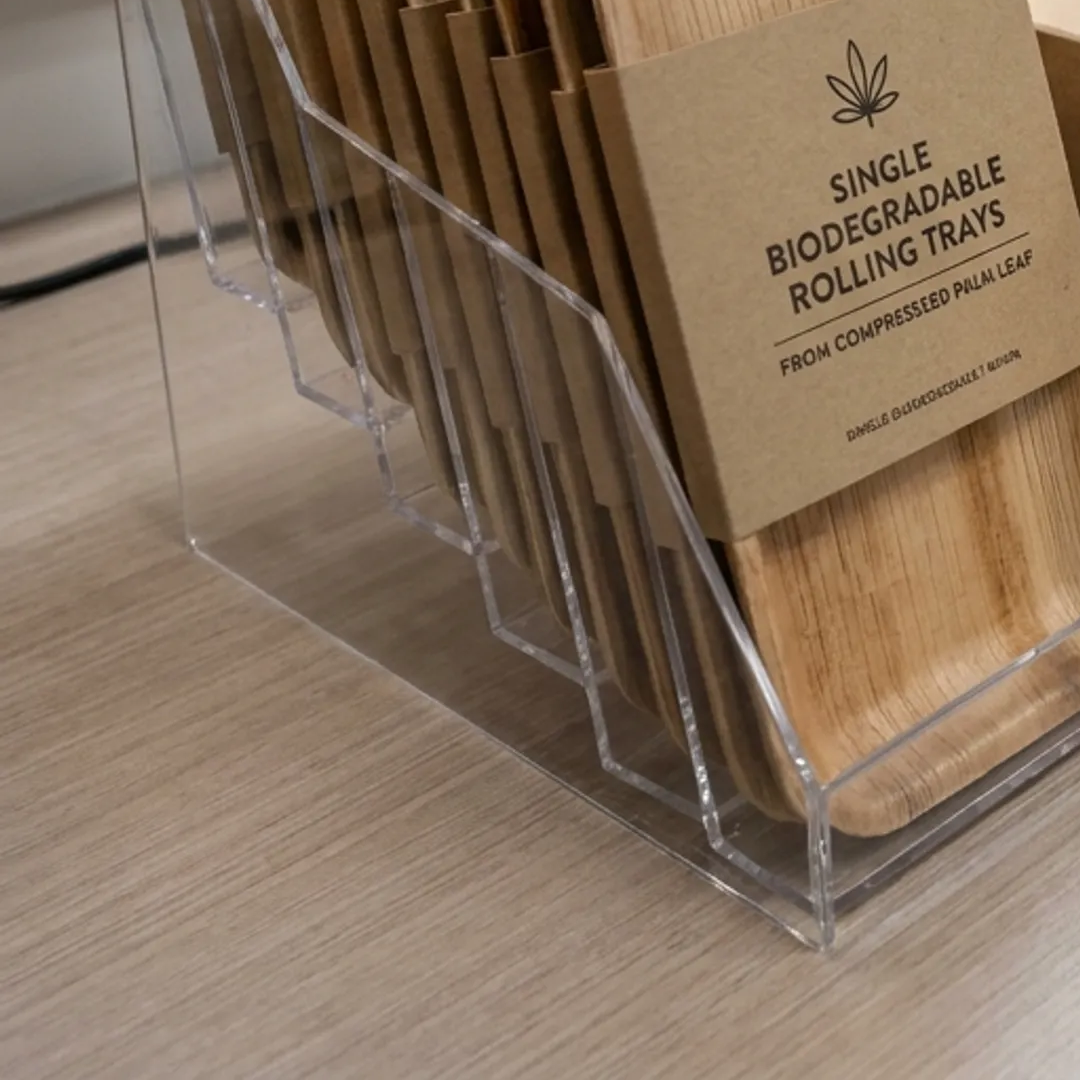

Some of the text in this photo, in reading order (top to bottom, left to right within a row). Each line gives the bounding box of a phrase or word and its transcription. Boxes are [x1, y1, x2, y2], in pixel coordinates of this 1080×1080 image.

[765, 154, 1006, 276] BIODEGRADABLE
[829, 140, 933, 204] SINGLE
[779, 343, 832, 377] FROM
[996, 248, 1034, 280] LEAF
[788, 198, 1006, 315] ROLLING TRAYS
